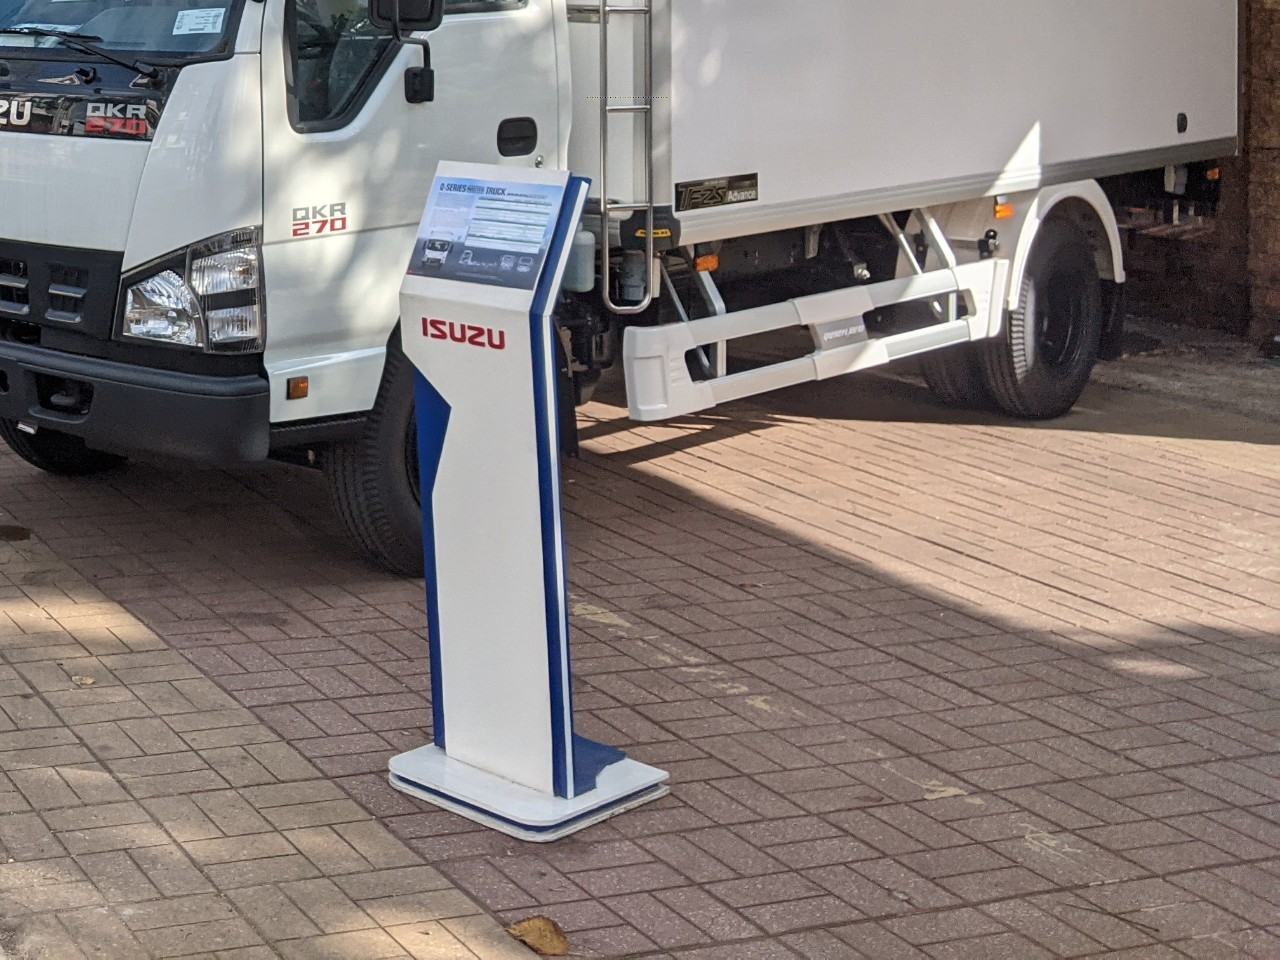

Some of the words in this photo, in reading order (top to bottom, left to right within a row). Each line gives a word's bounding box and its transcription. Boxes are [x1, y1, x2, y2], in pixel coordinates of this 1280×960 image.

[86, 102, 147, 118] QKR
[85, 116, 146, 135] 270
[485, 186, 507, 196] TRUCK
[292, 202, 347, 222] QKR
[292, 217, 347, 237] 270
[421, 317, 506, 351] ISUZU
